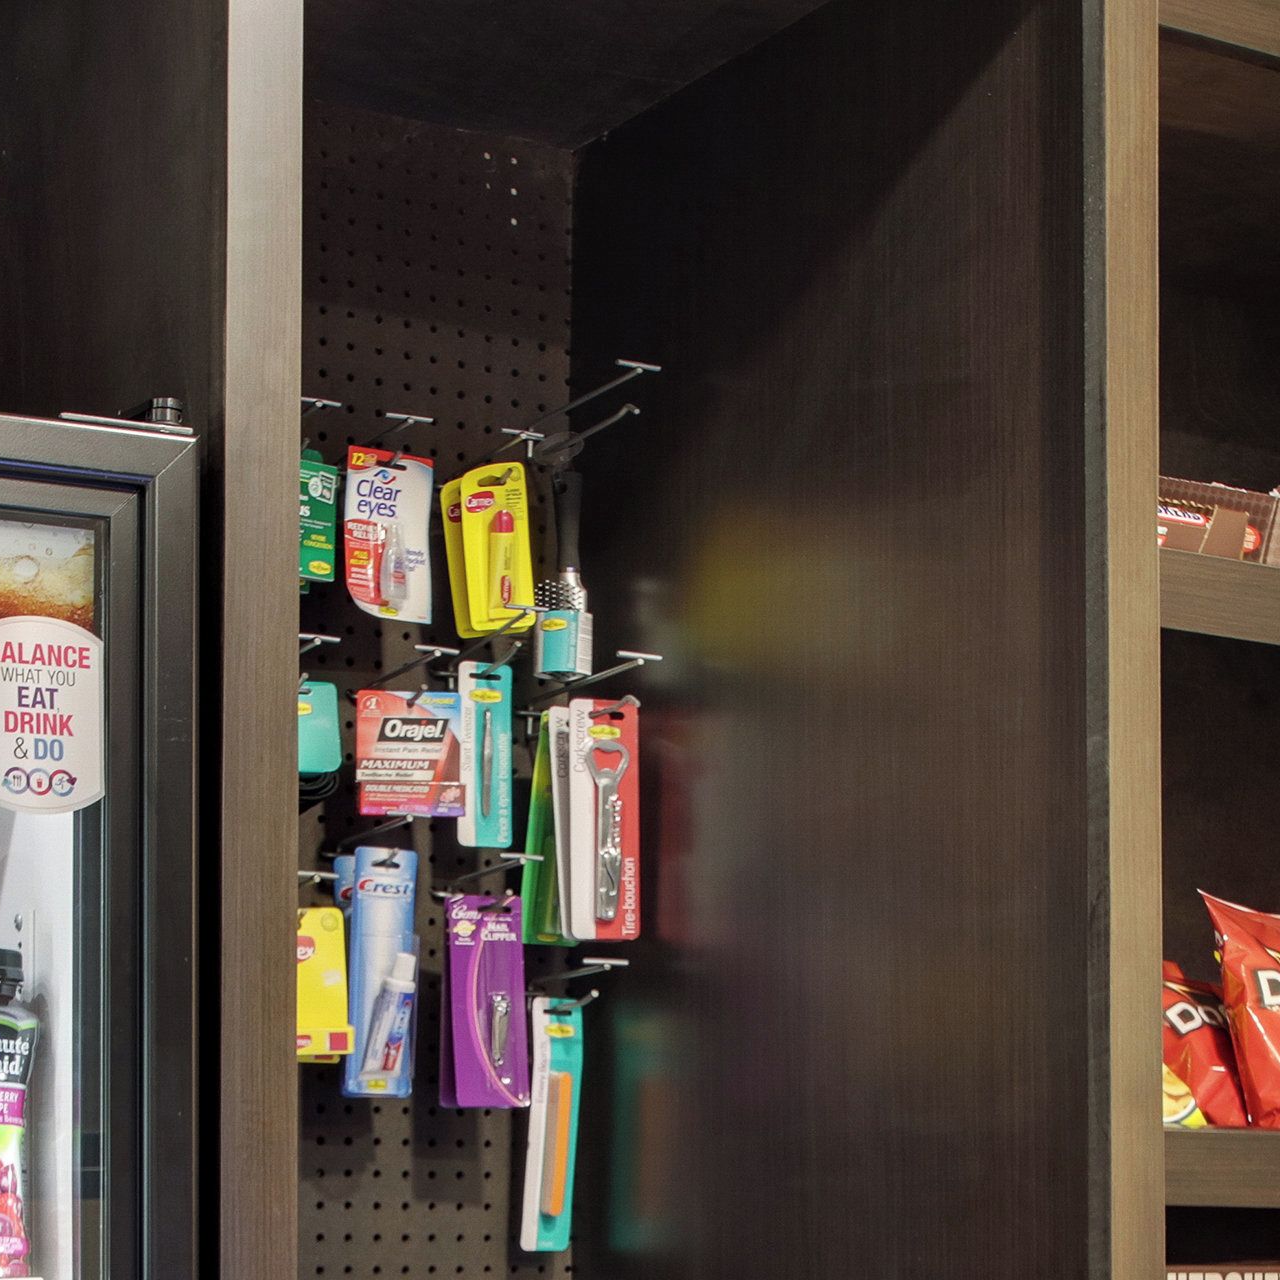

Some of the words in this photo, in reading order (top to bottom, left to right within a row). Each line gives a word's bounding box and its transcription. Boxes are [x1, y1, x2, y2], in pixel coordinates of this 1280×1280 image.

[350, 453, 365, 466] 12
[356, 479, 402, 501] Clear
[357, 500, 397, 519] eyes
[1, 666, 42, 683] WHAT
[47, 670, 76, 687] YOU
[17, 686, 60, 712] EAT,
[4, 711, 74, 736] DRINK
[384, 719, 444, 741] Orajel
[13, 737, 28, 760] &
[34, 738, 64, 761] DO
[573, 709, 586, 772] Corkscrew
[360, 759, 430, 769] MAXIMUM
[358, 879, 410, 895] Crest
[622, 857, 636, 936] Tire-bouchon
[480, 930, 517, 942] CLIPPER
[487, 922, 509, 932] NAIL
